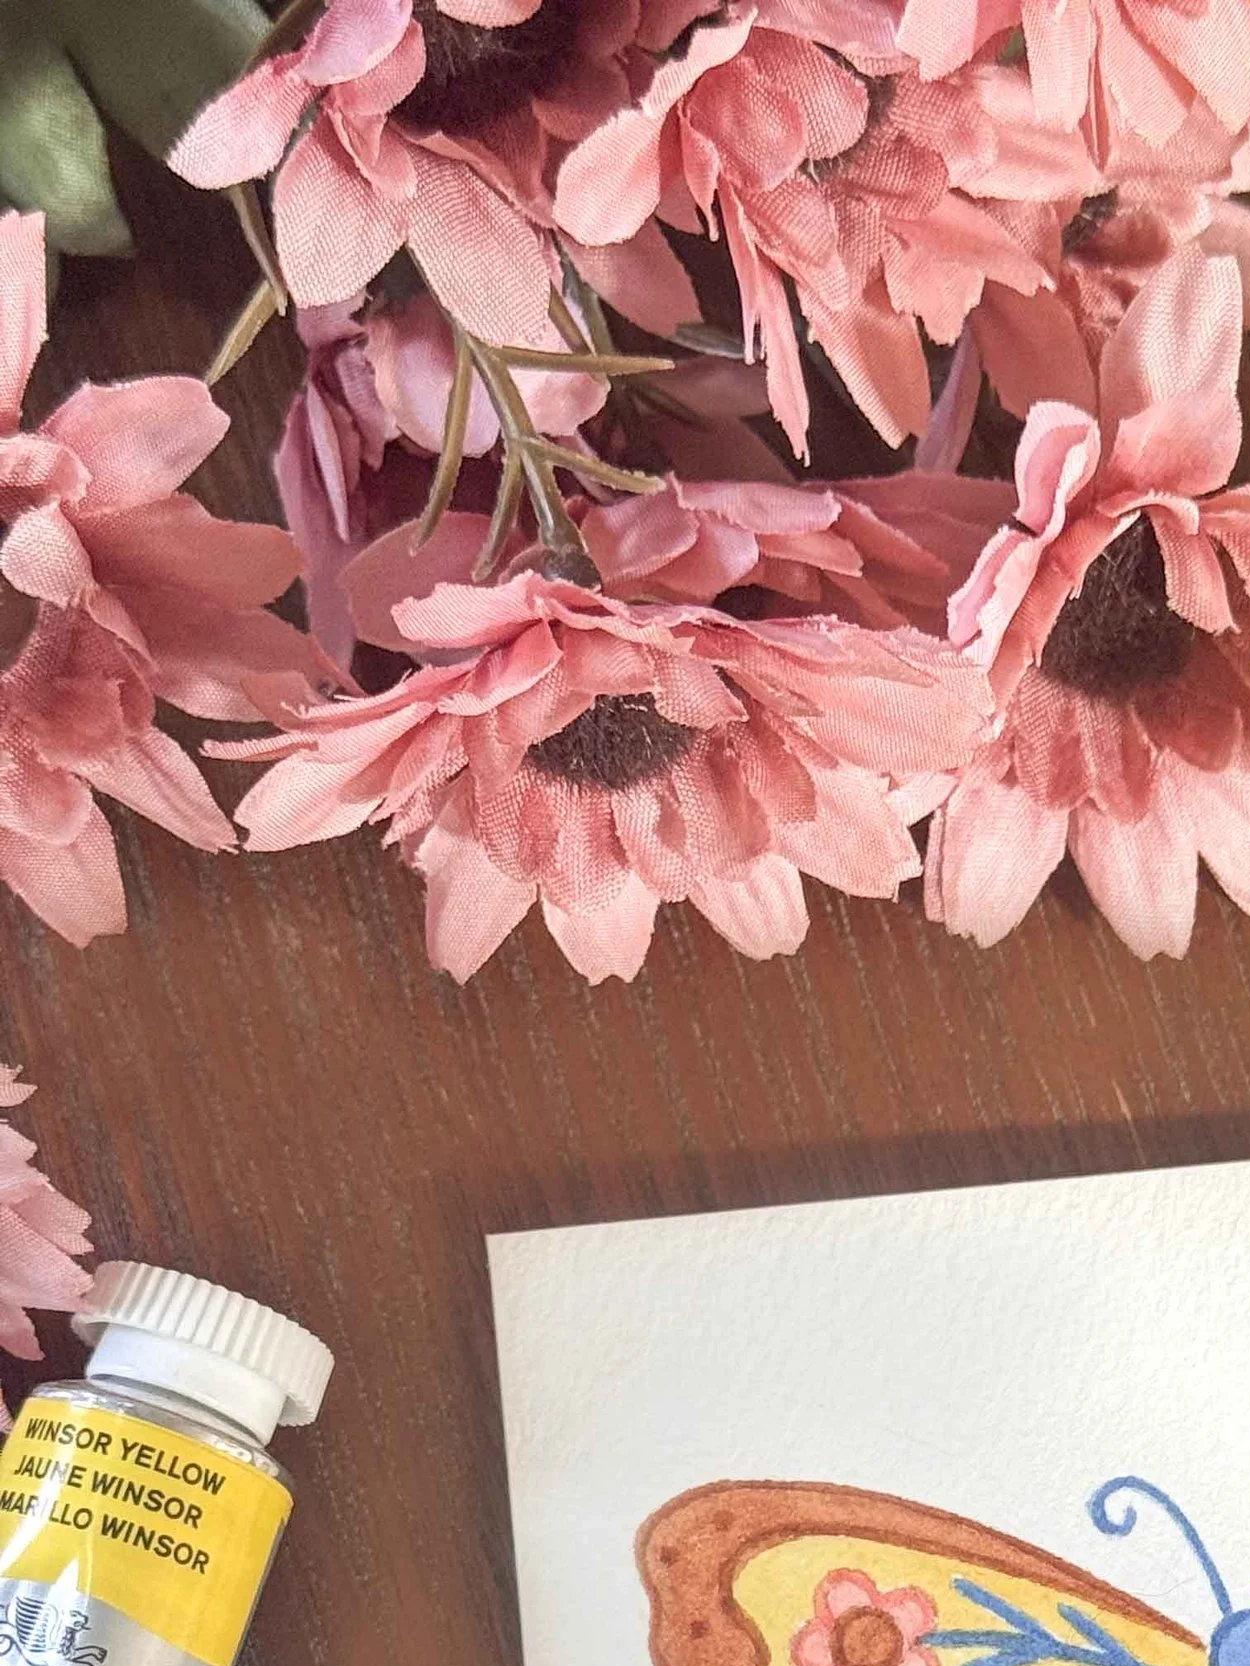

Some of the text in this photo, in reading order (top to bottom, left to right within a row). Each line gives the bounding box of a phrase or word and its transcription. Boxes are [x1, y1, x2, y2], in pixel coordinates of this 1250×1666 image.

[14, 1455, 203, 1529] JAUNE WINSOR
[25, 1418, 226, 1496] WINSOR YELLOW
[100, 1514, 209, 1575] WINSOR
